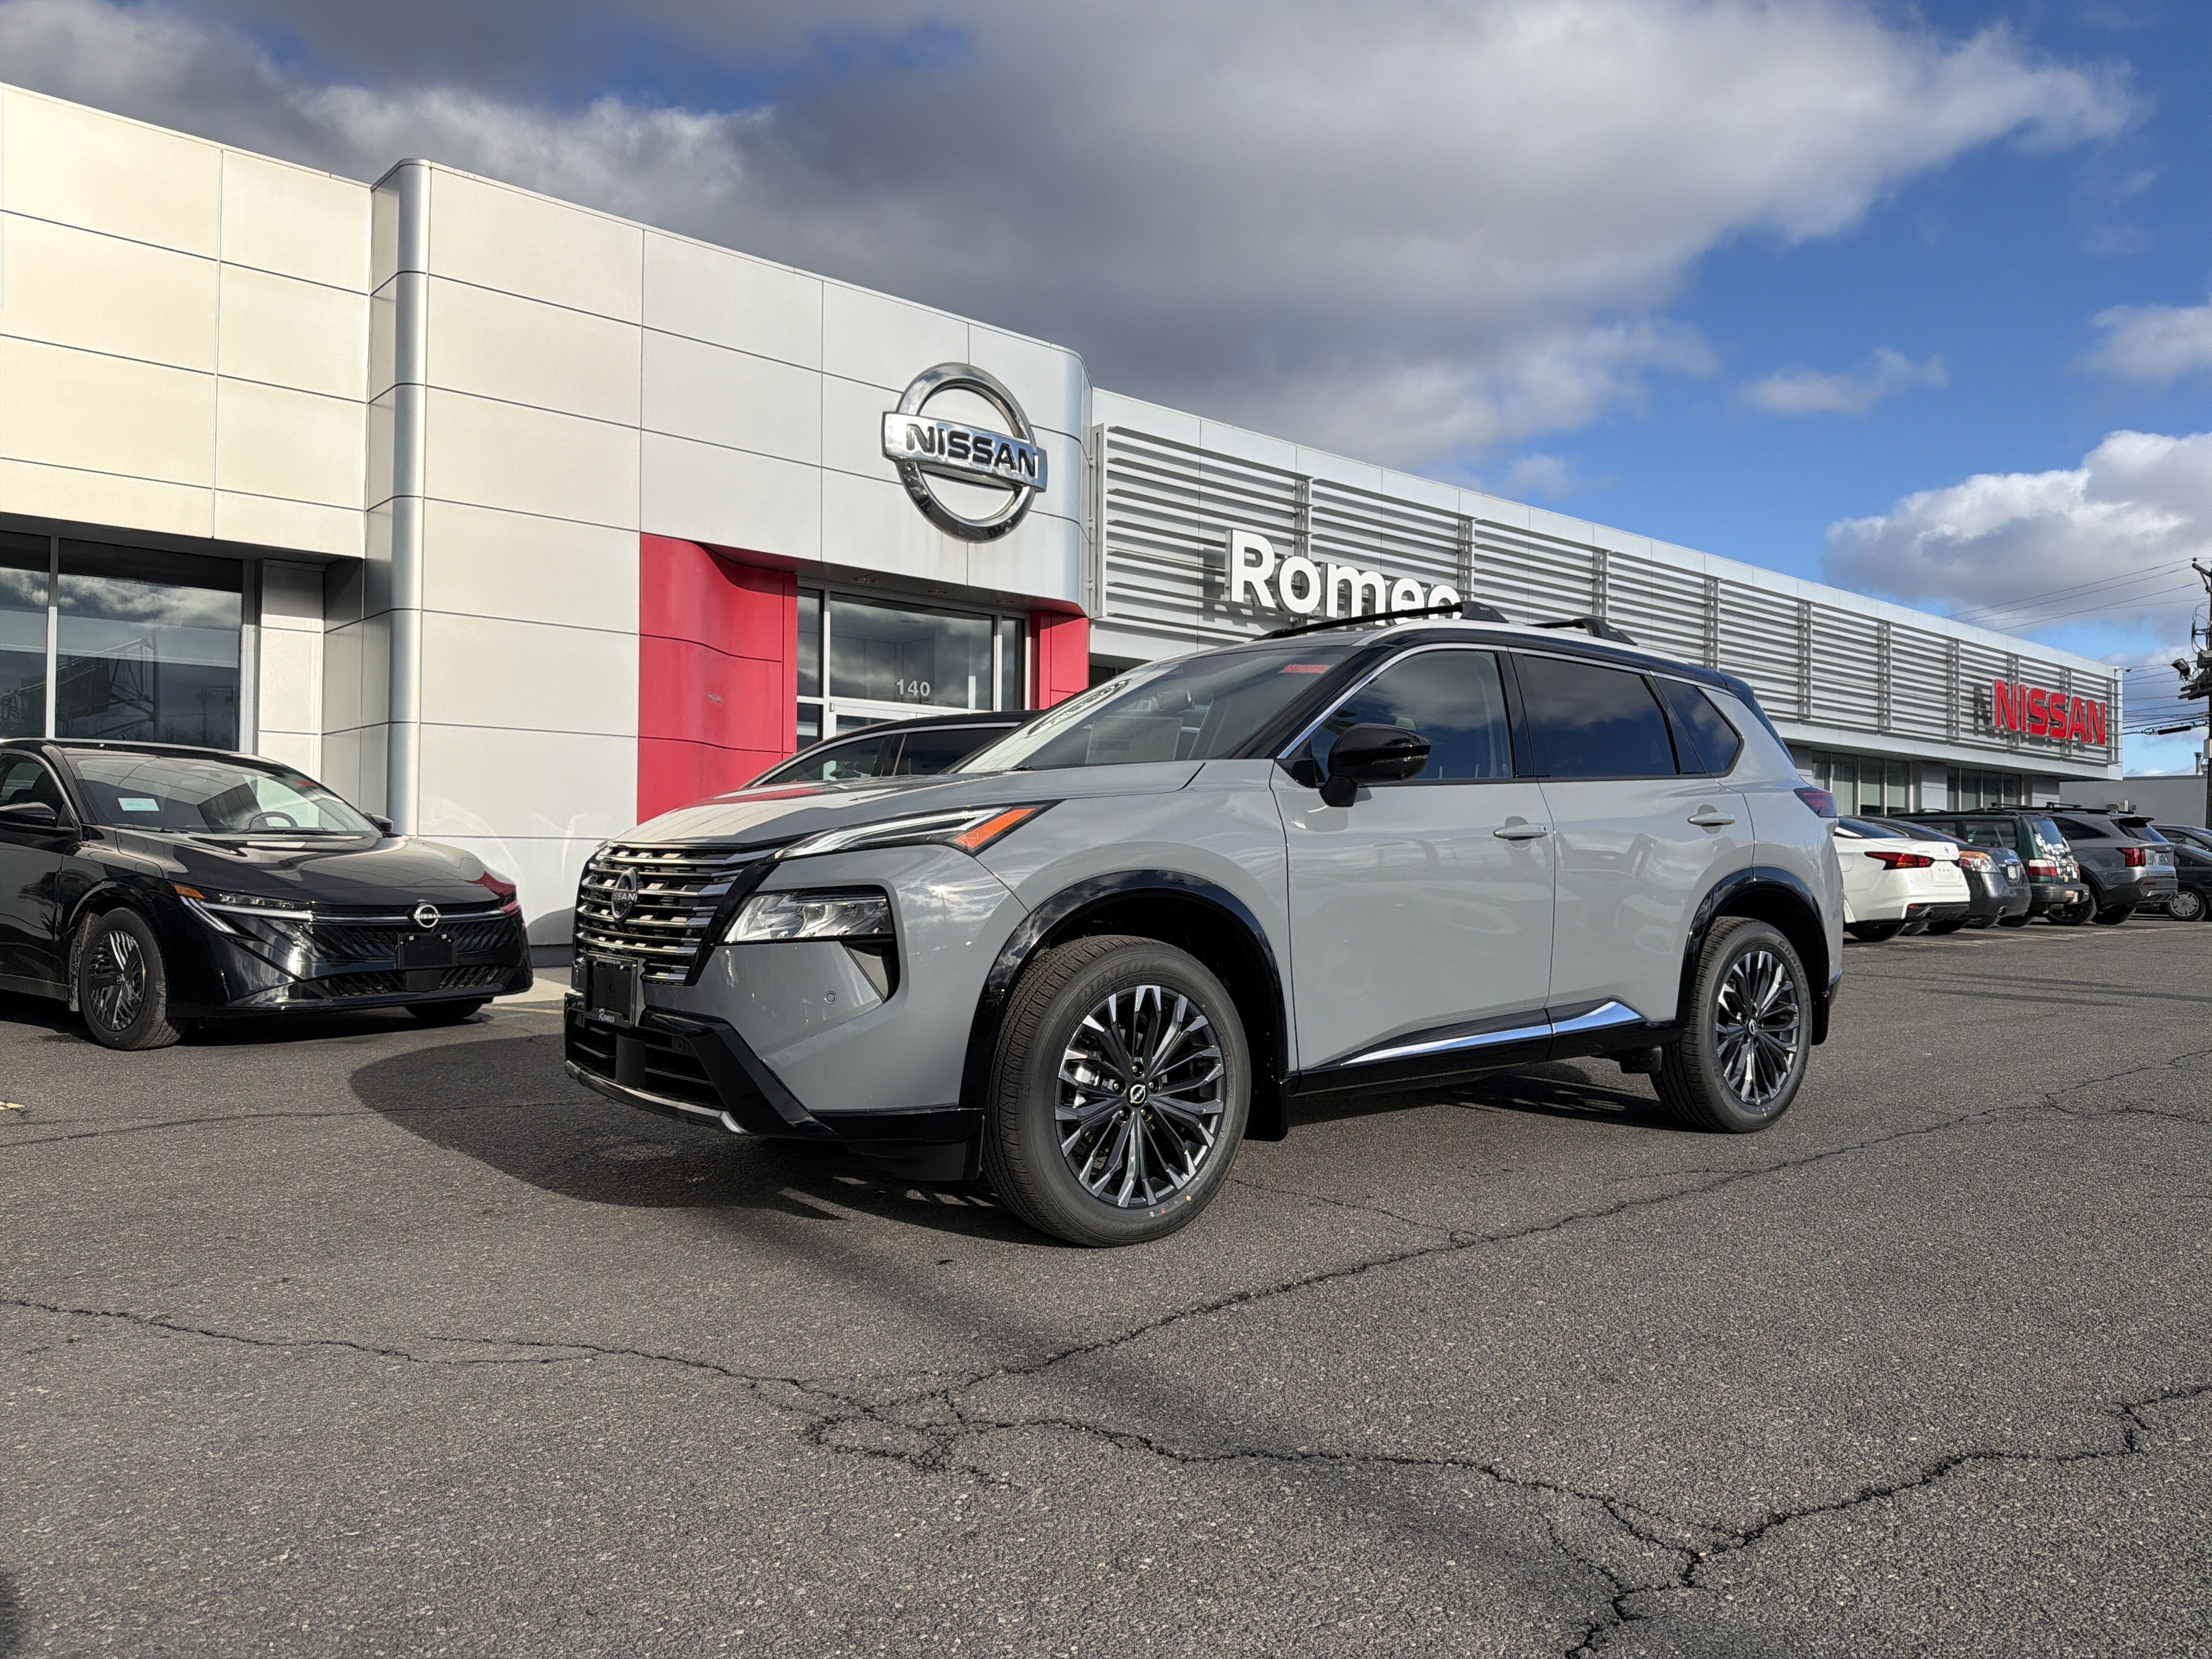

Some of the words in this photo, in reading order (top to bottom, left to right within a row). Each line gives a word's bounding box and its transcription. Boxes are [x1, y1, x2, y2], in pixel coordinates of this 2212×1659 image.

[906, 423, 1039, 479] NISSAN
[896, 679, 931, 697] 140
[1994, 679, 2106, 745] NISSAN
[613, 891, 636, 901] SSAN
